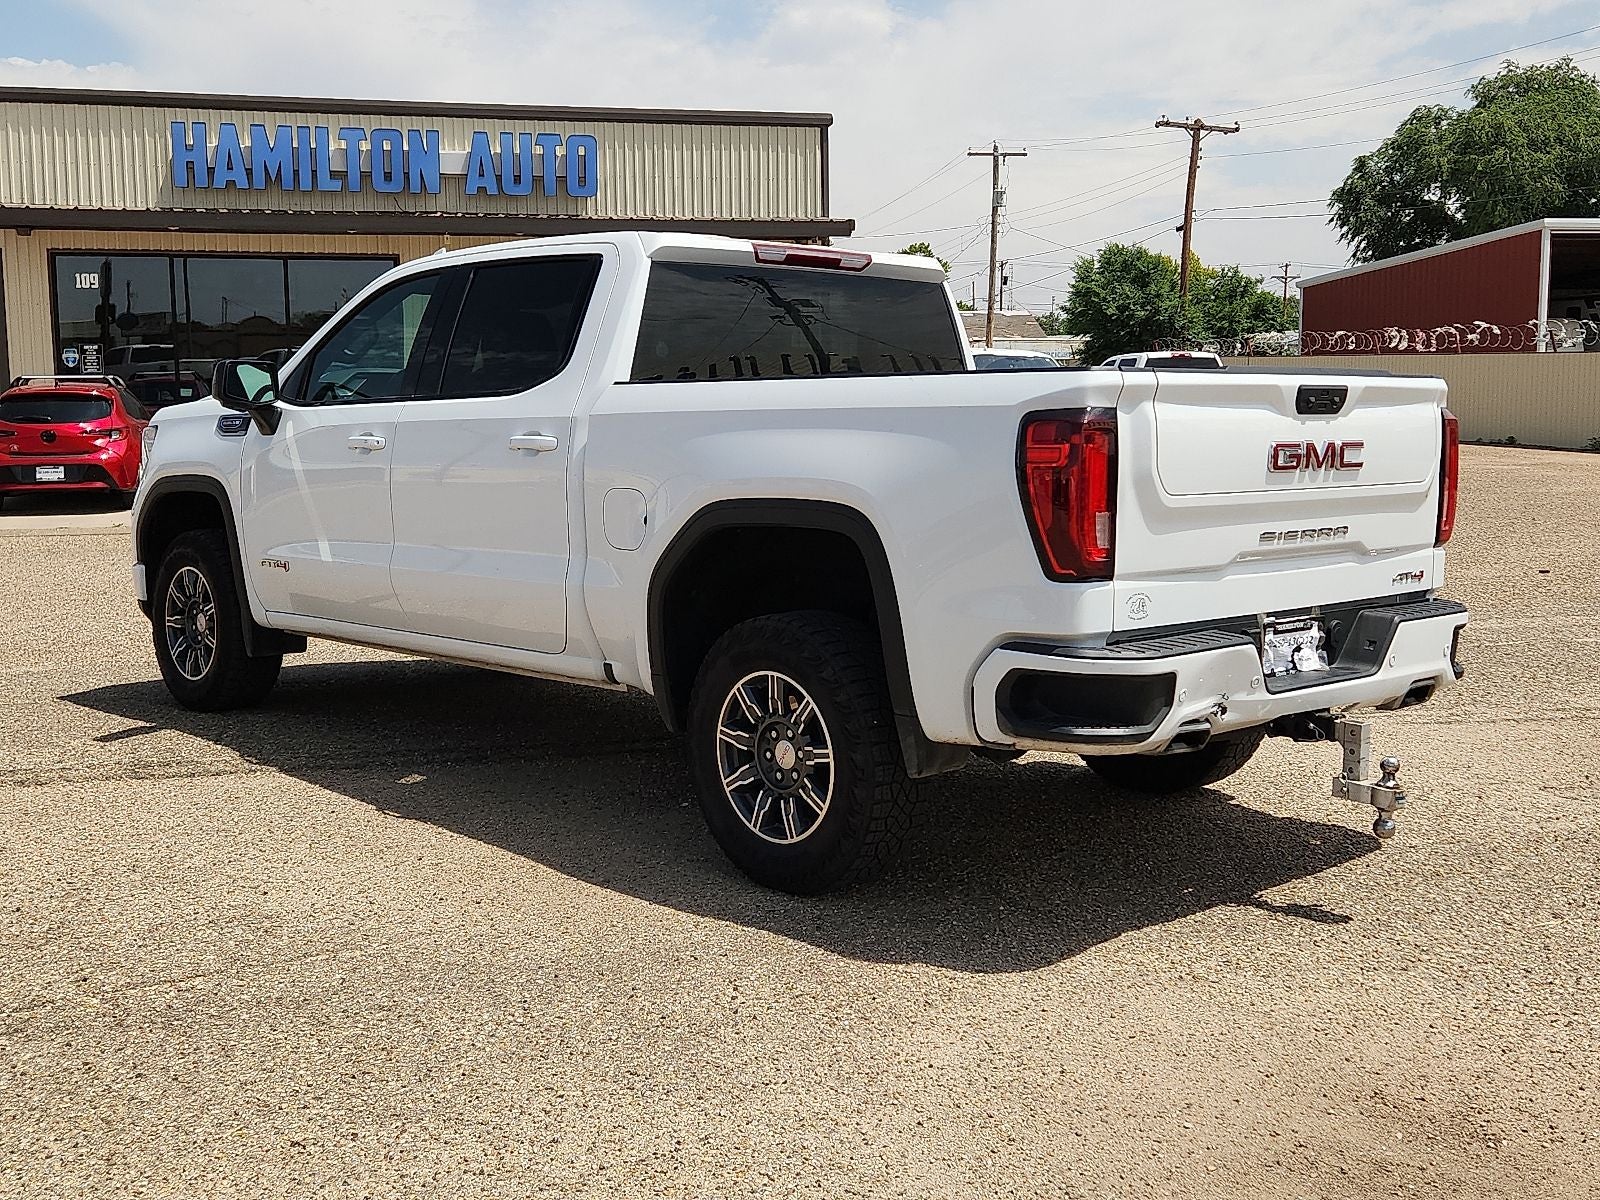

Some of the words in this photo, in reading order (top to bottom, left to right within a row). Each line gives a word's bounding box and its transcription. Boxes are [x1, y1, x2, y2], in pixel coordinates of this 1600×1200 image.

[170, 121, 441, 194] HAMILTON
[465, 131, 598, 198] AUTO
[75, 273, 100, 289] 109
[1267, 440, 1364, 473] GMC
[1259, 525, 1349, 543] SIERRA
[1391, 569, 1424, 586] AT4
